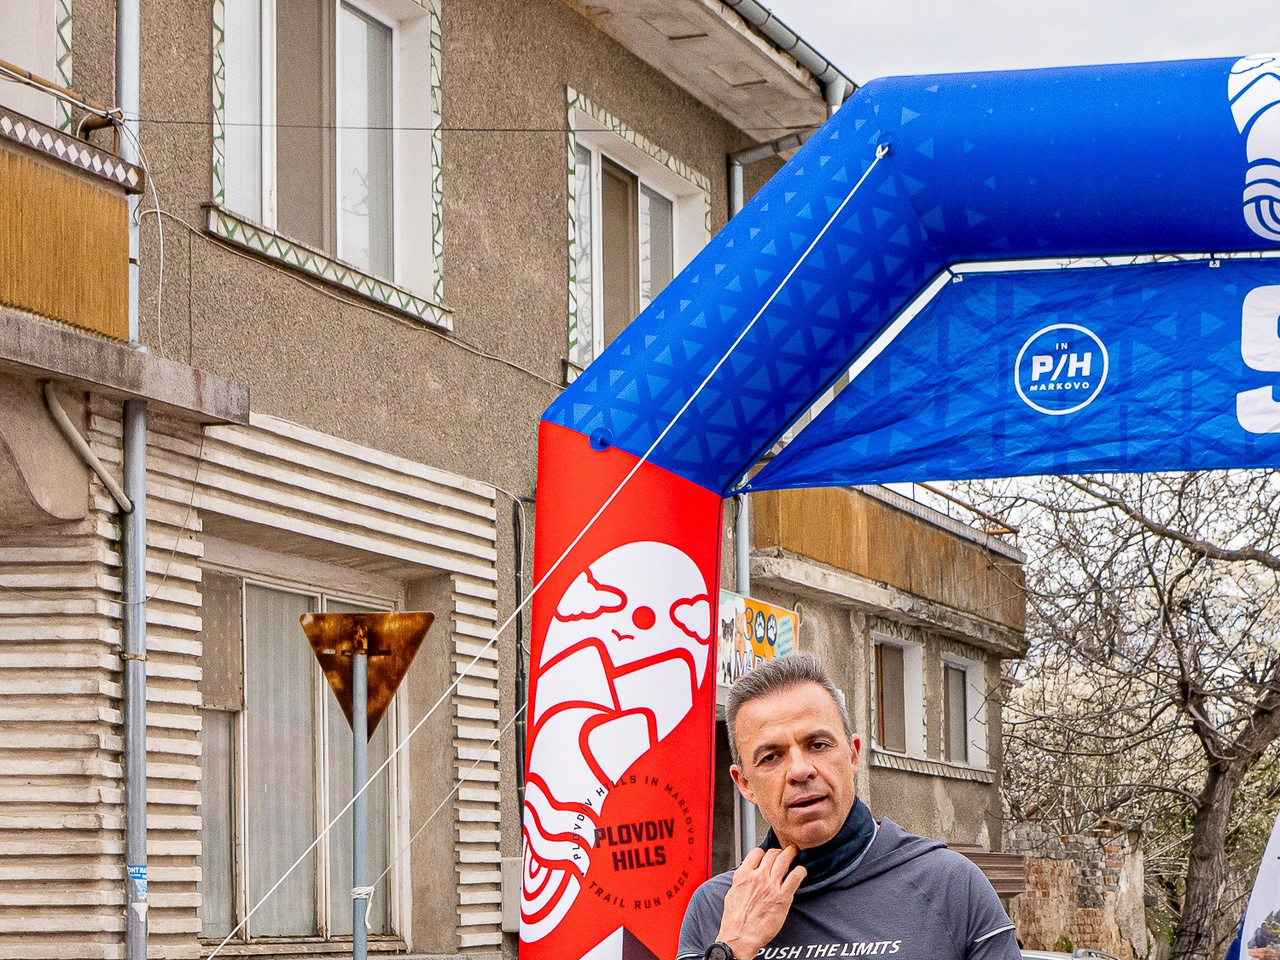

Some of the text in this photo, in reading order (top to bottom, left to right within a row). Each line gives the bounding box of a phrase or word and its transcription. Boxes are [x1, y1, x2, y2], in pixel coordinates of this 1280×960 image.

[1056, 342, 1068, 350] IN
[1029, 381, 1090, 391] MARKOVO
[593, 818, 675, 849] PLOVDIV
[612, 846, 667, 872] HILLS
[588, 870, 690, 910] TRAIL RUN RACE
[805, 943, 841, 958] THE
[840, 940, 902, 957] LIMITS
